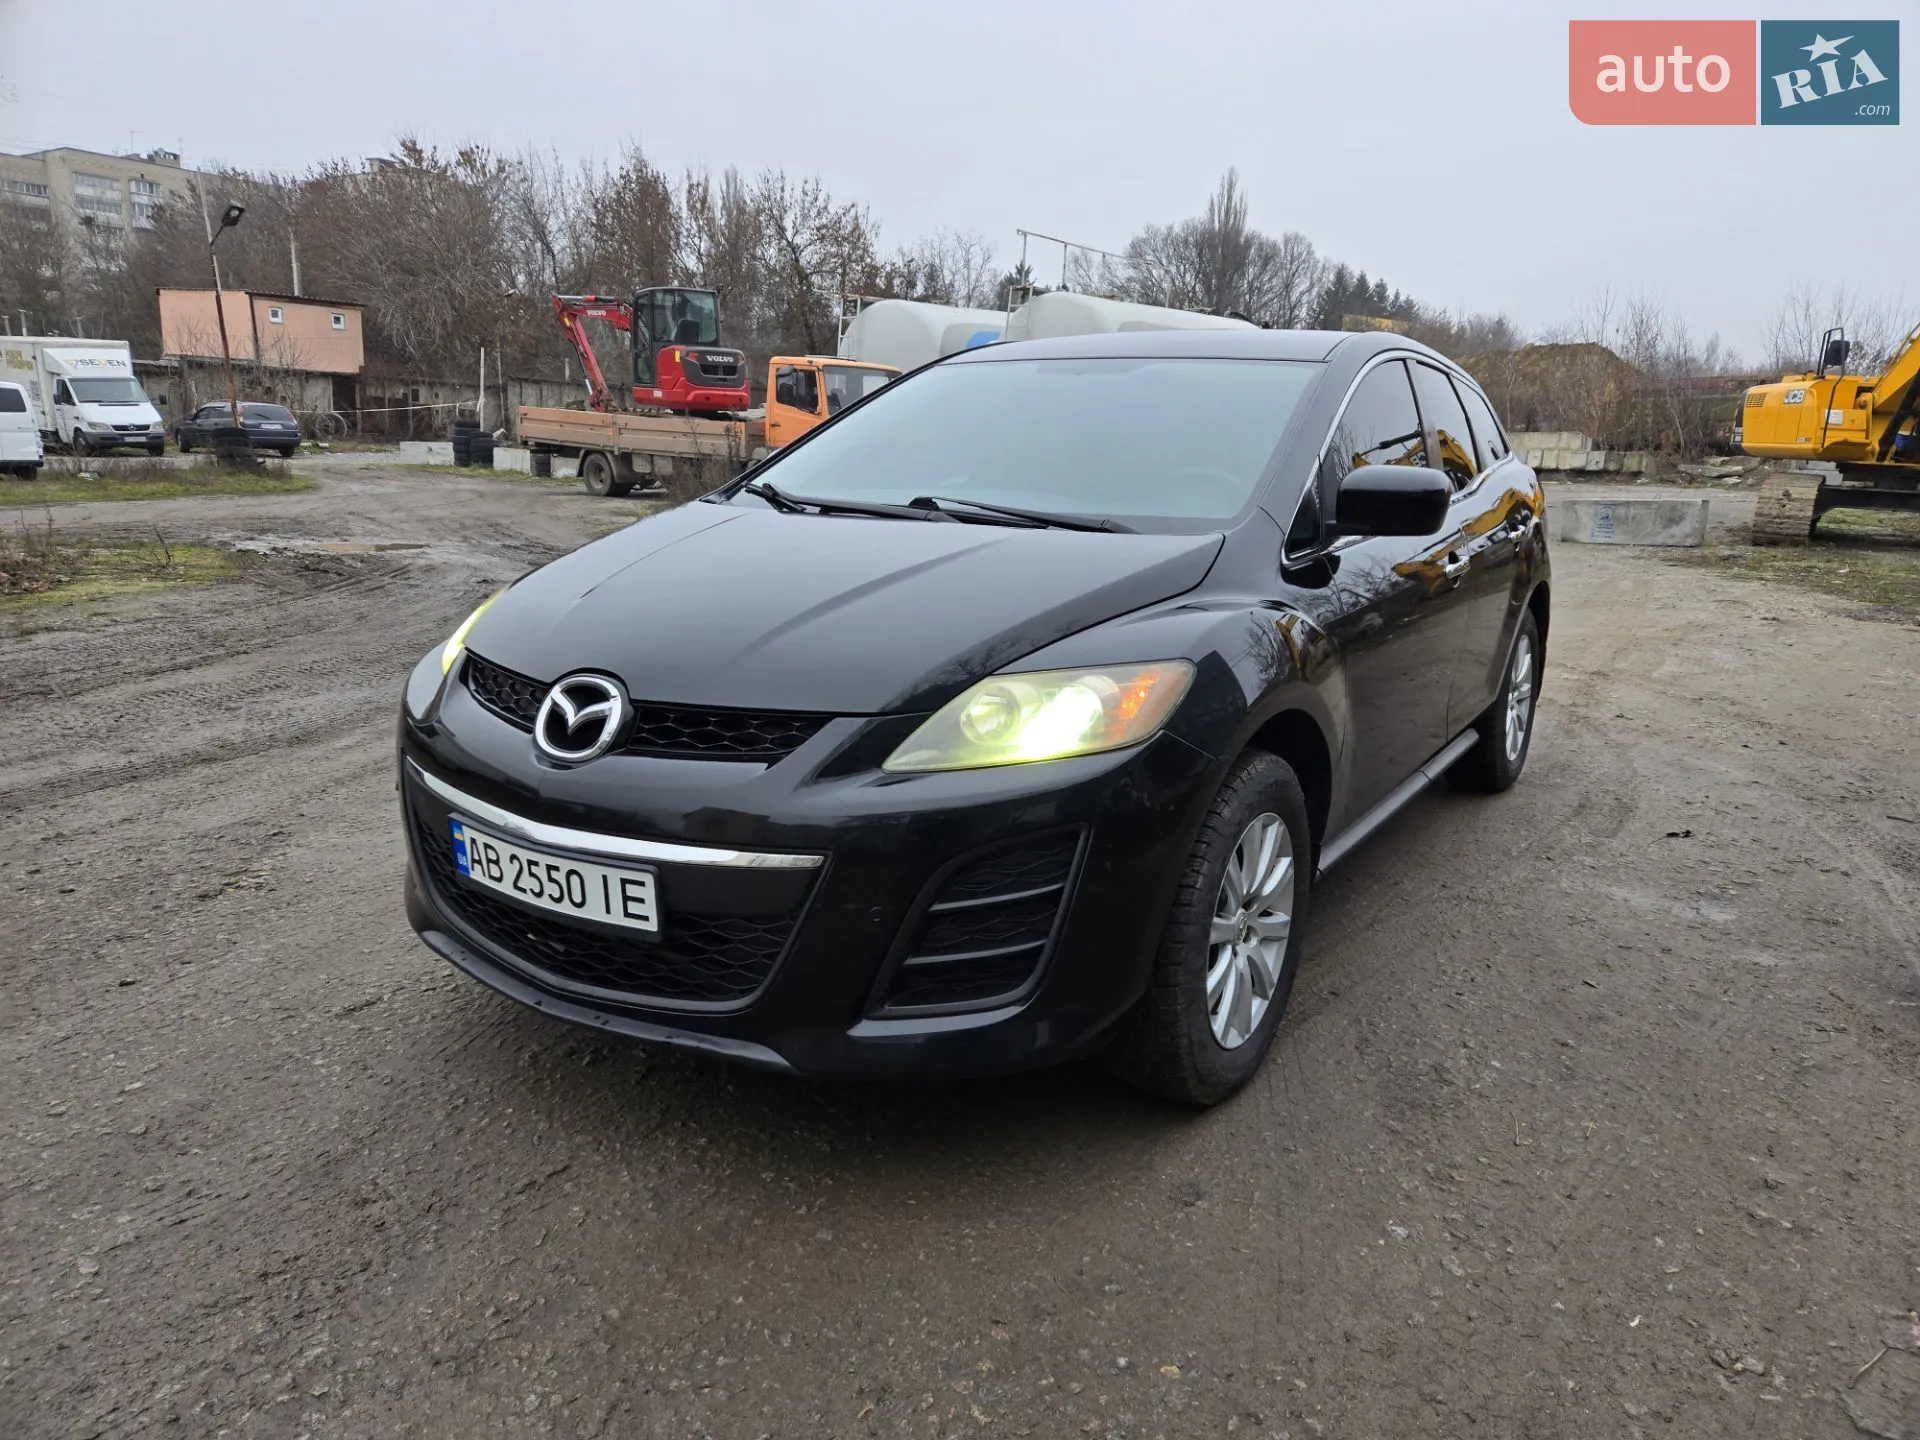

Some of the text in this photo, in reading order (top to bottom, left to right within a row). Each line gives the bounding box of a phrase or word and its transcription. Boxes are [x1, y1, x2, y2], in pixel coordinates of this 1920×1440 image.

[80, 358, 127, 368] SEVEN
[705, 355, 734, 363] VOLVO
[1784, 389, 1805, 403] JCB
[457, 852, 469, 867] UA
[470, 837, 650, 922] AB 2550 IE
